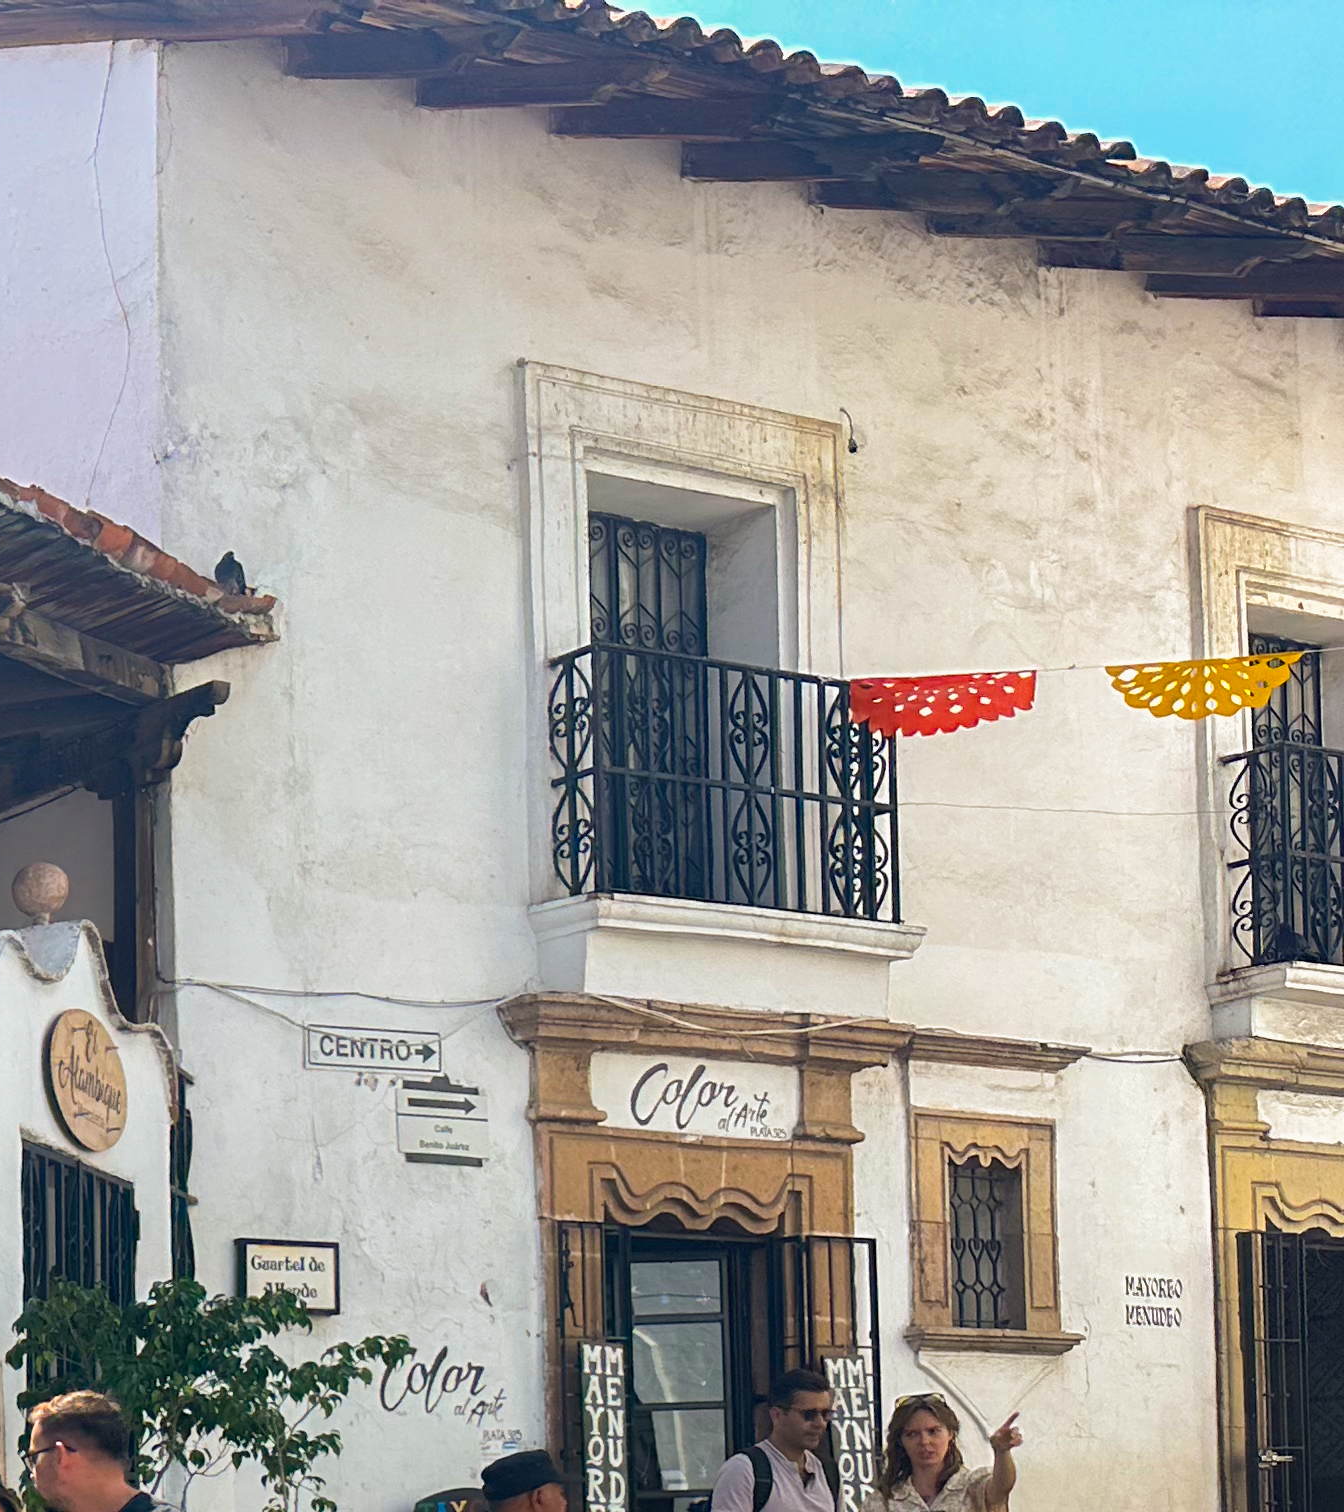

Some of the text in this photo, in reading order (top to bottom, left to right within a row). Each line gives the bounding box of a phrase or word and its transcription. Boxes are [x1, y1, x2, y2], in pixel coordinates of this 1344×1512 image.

[319, 1034, 411, 1062] CENTRO
[630, 1062, 739, 1130] Color
[434, 1124, 453, 1134] Calle
[419, 1139, 444, 1149] Benito
[308, 1256, 326, 1272] de
[1125, 1275, 1184, 1299] MAYOREO
[1125, 1304, 1183, 1328] MENUDEO
